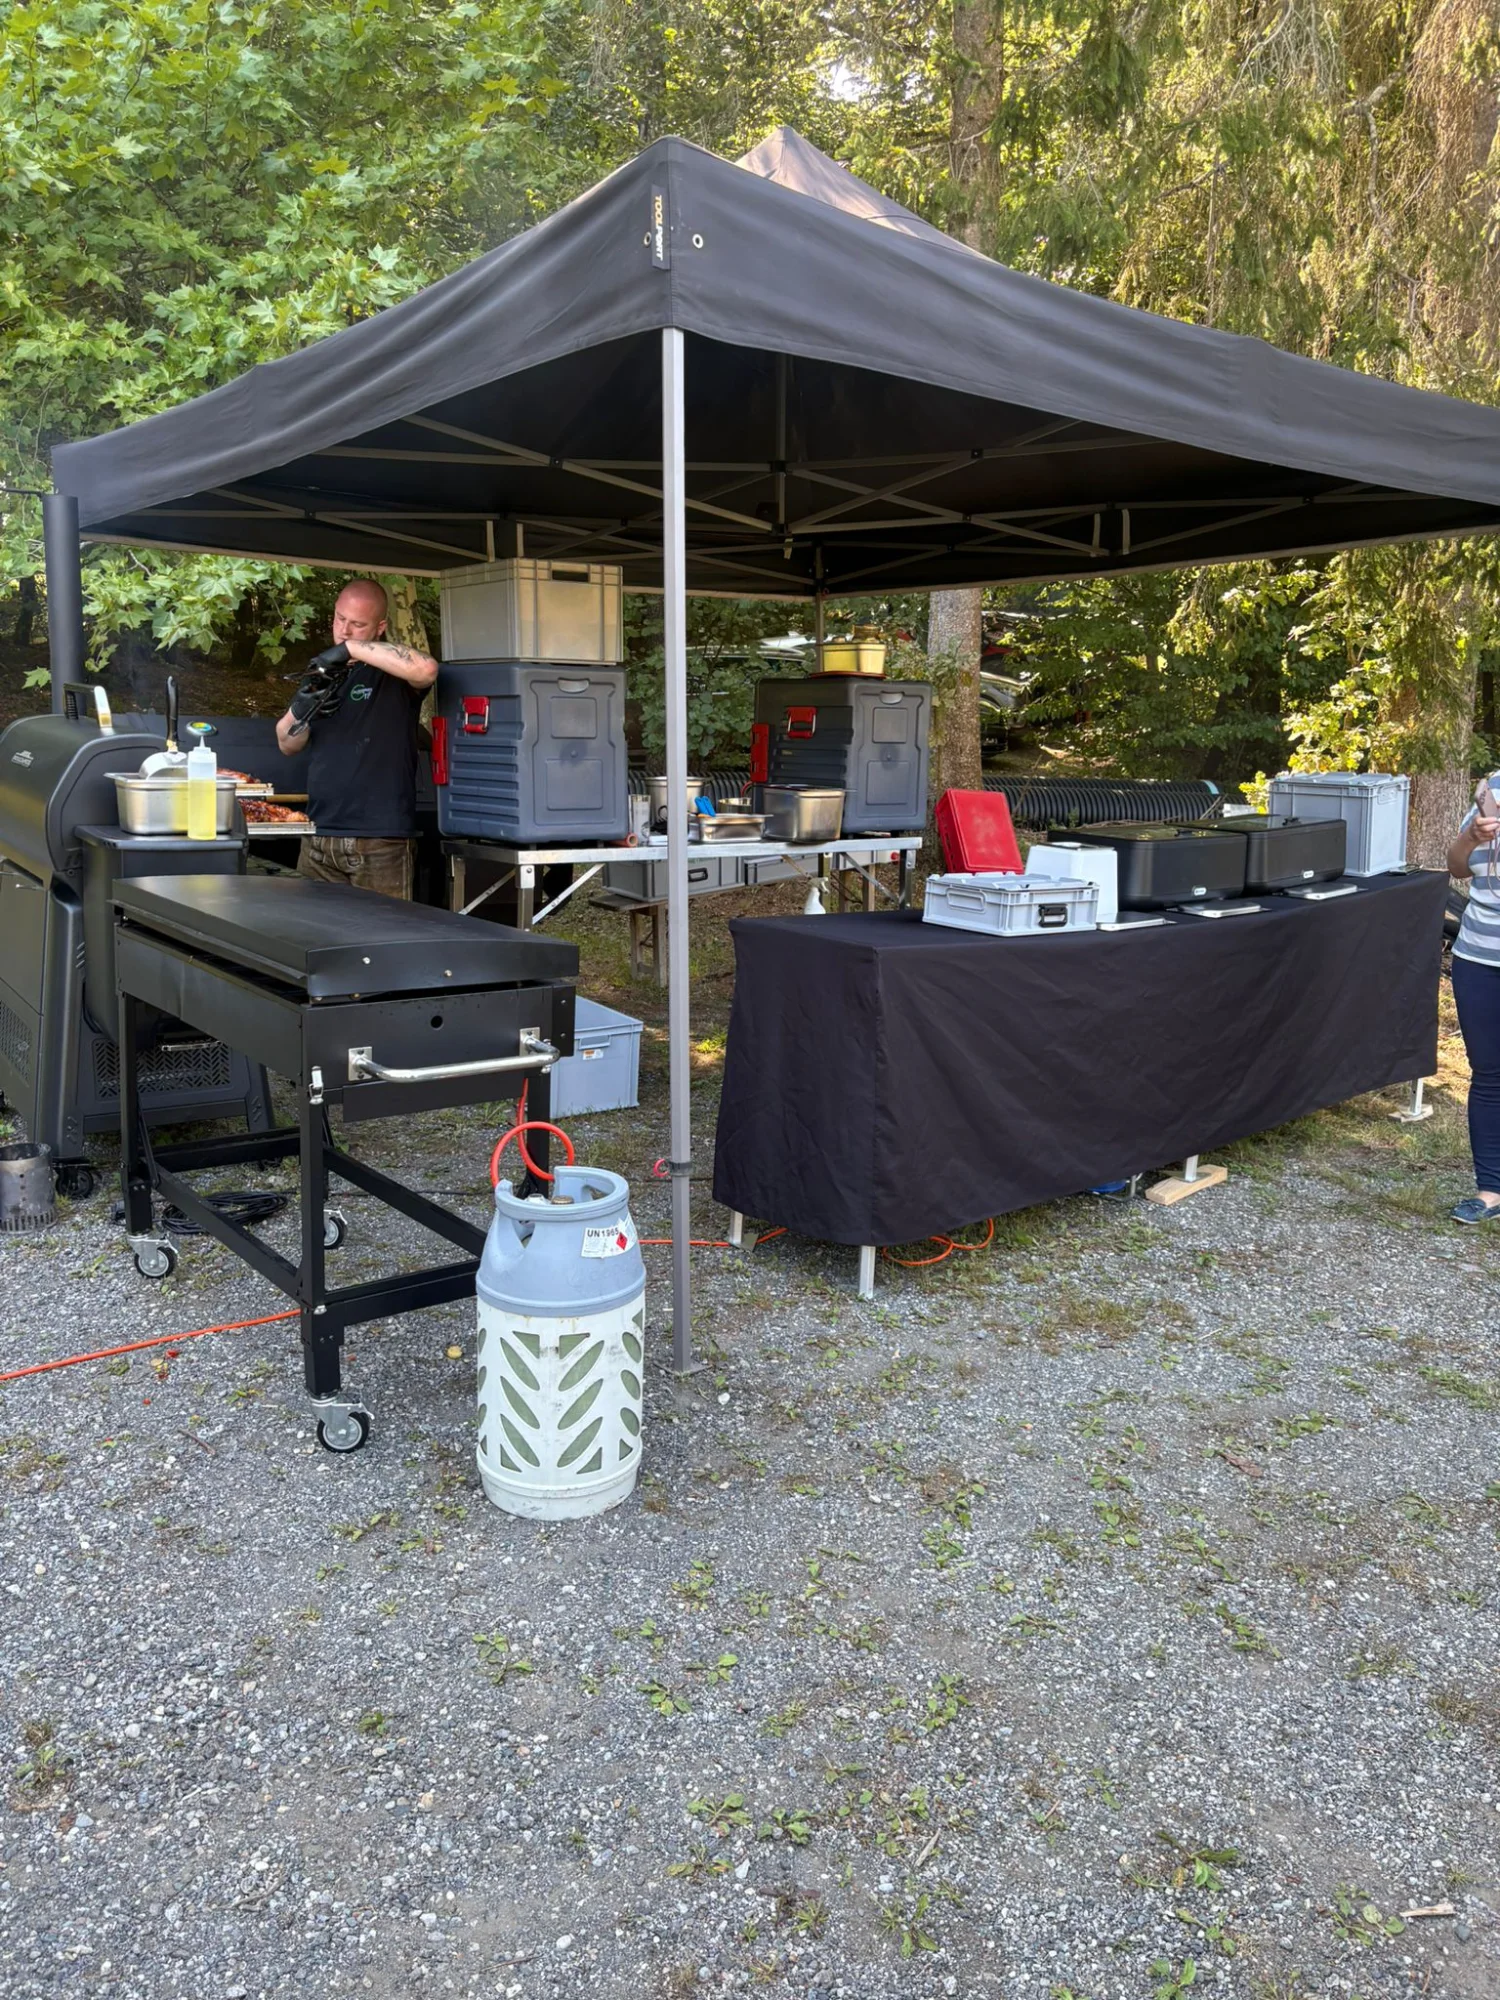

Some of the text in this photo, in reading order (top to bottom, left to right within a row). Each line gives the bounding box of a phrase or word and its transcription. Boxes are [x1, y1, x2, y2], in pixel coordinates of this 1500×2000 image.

[654, 194, 663, 261] TOOLPORT
[587, 1227, 619, 1238] UN 1965
